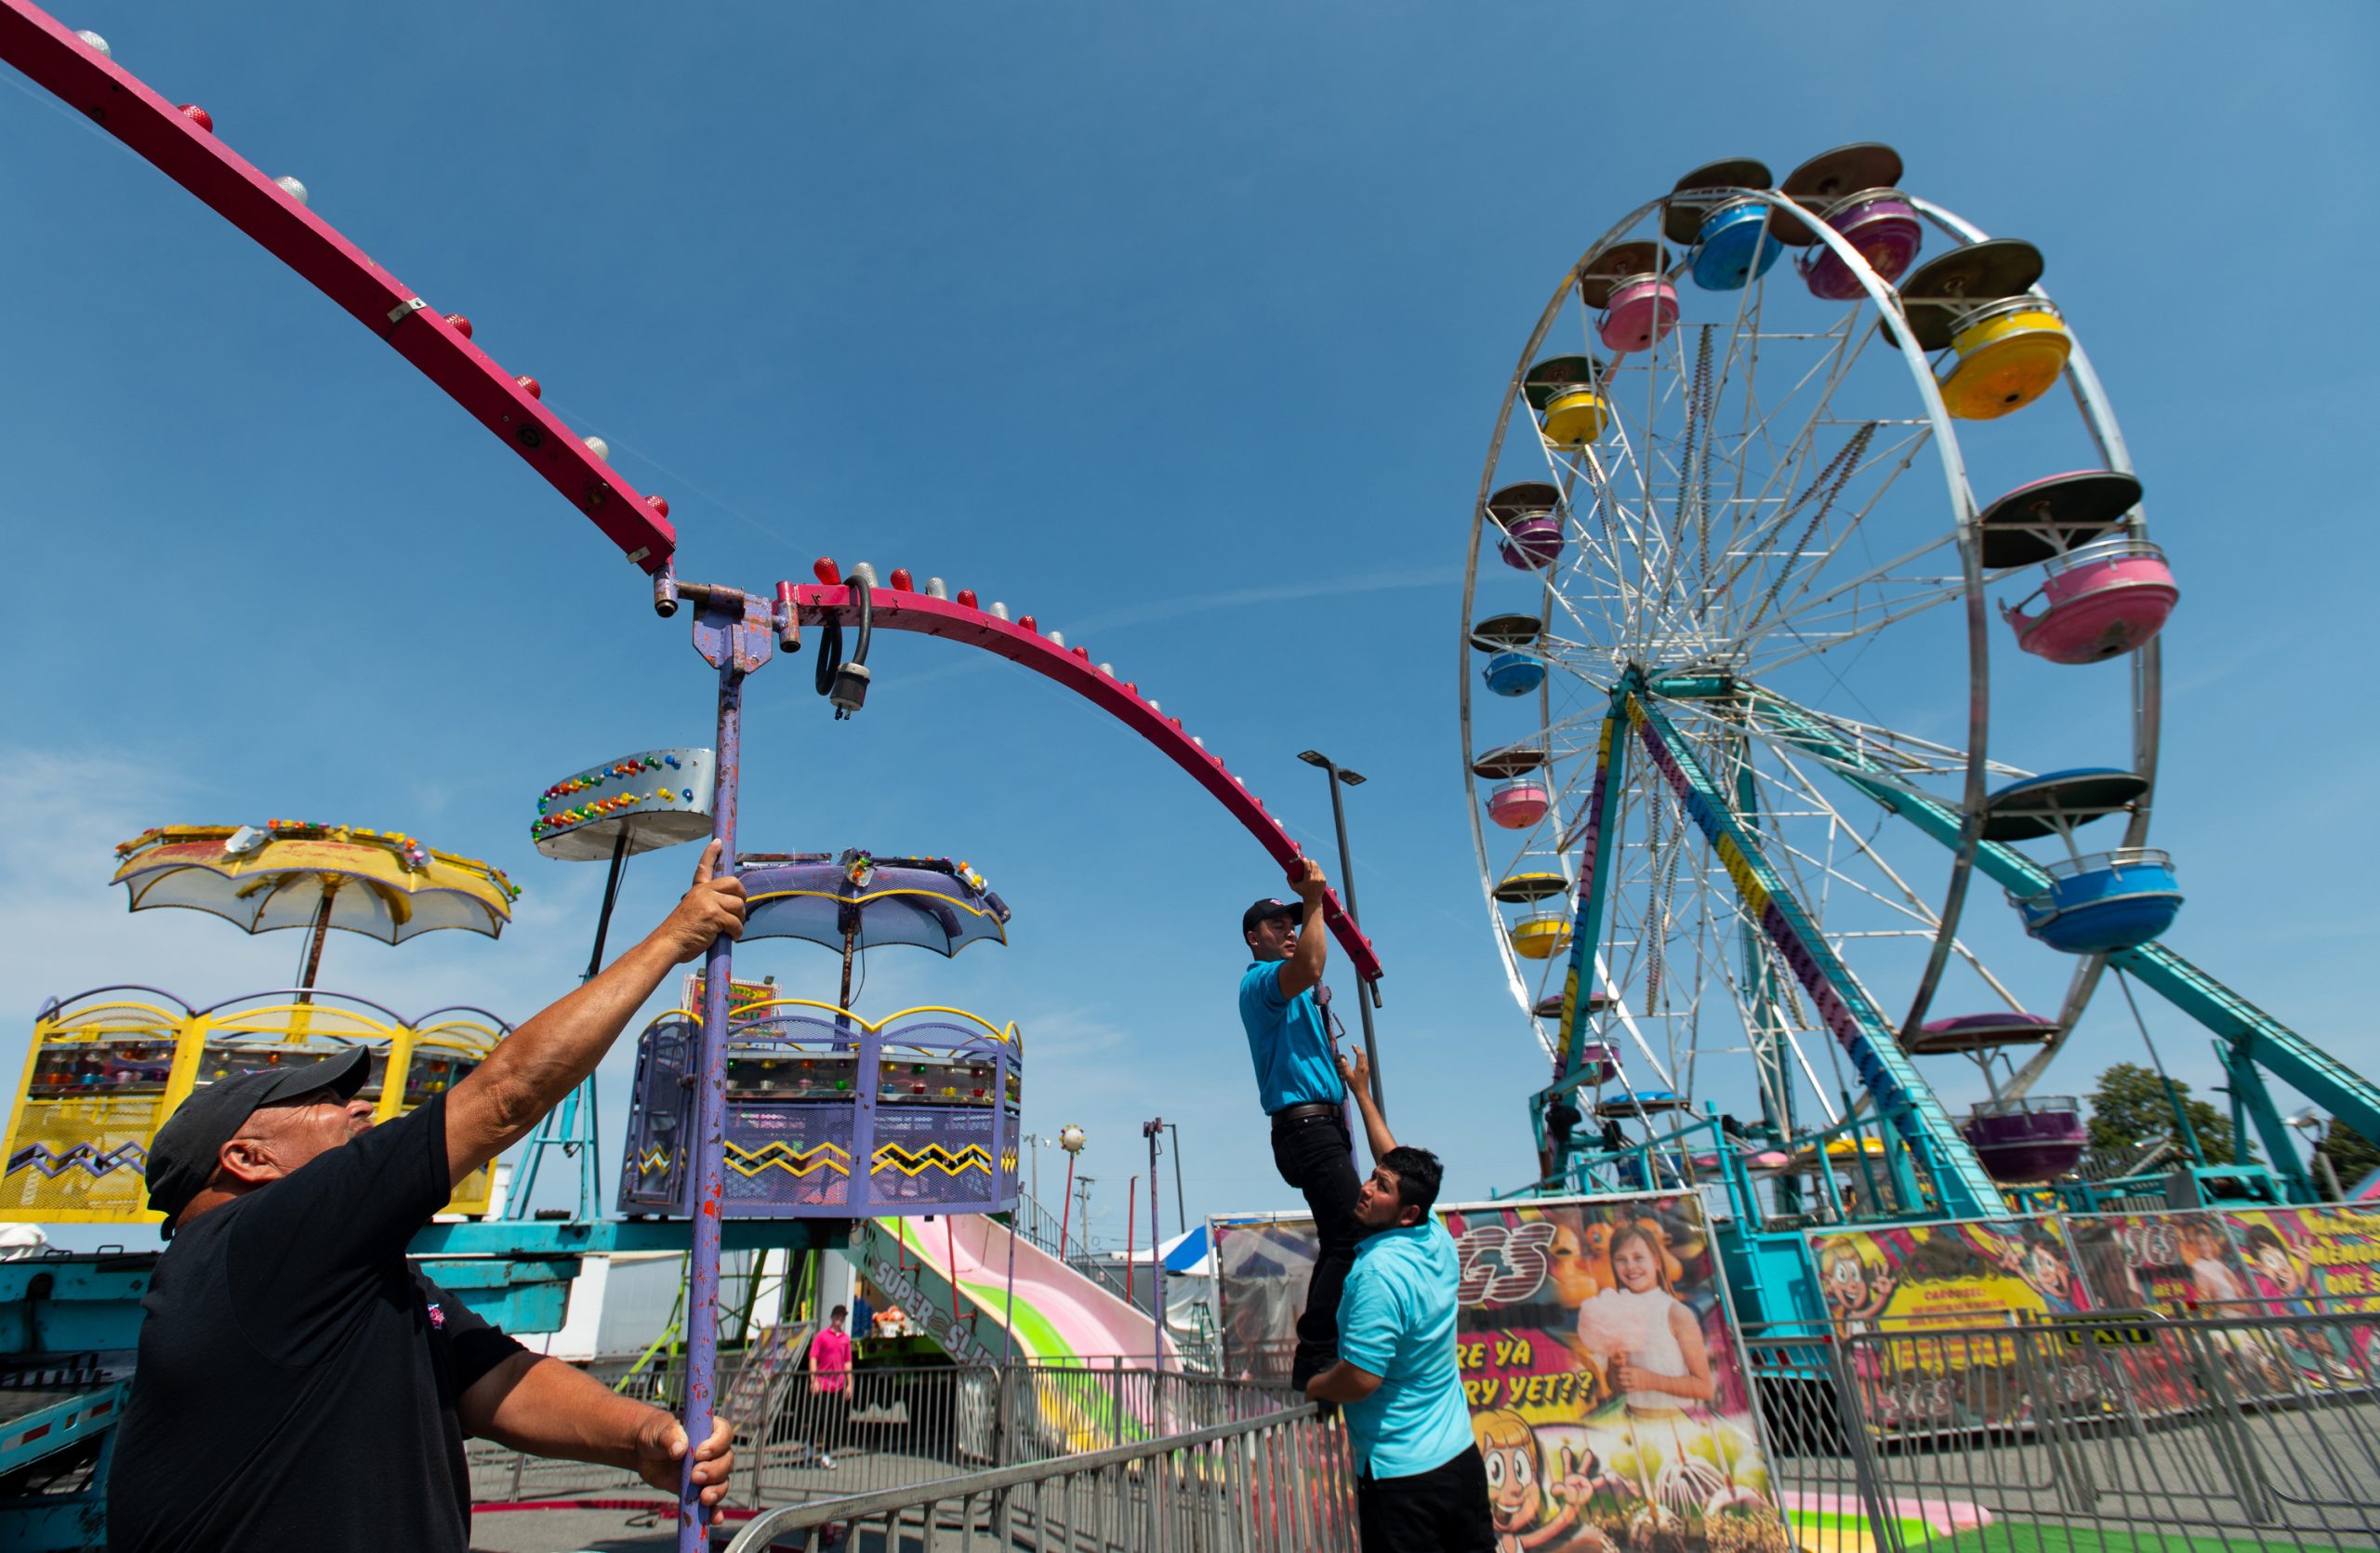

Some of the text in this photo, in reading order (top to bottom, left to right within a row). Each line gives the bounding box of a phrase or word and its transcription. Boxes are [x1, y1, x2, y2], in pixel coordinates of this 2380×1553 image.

[1457, 1221, 1558, 1306] GS
[874, 1259, 935, 1330] SUPER
[1457, 1341, 1487, 1370] RE
[1463, 1371, 1594, 1407] RY YET??
